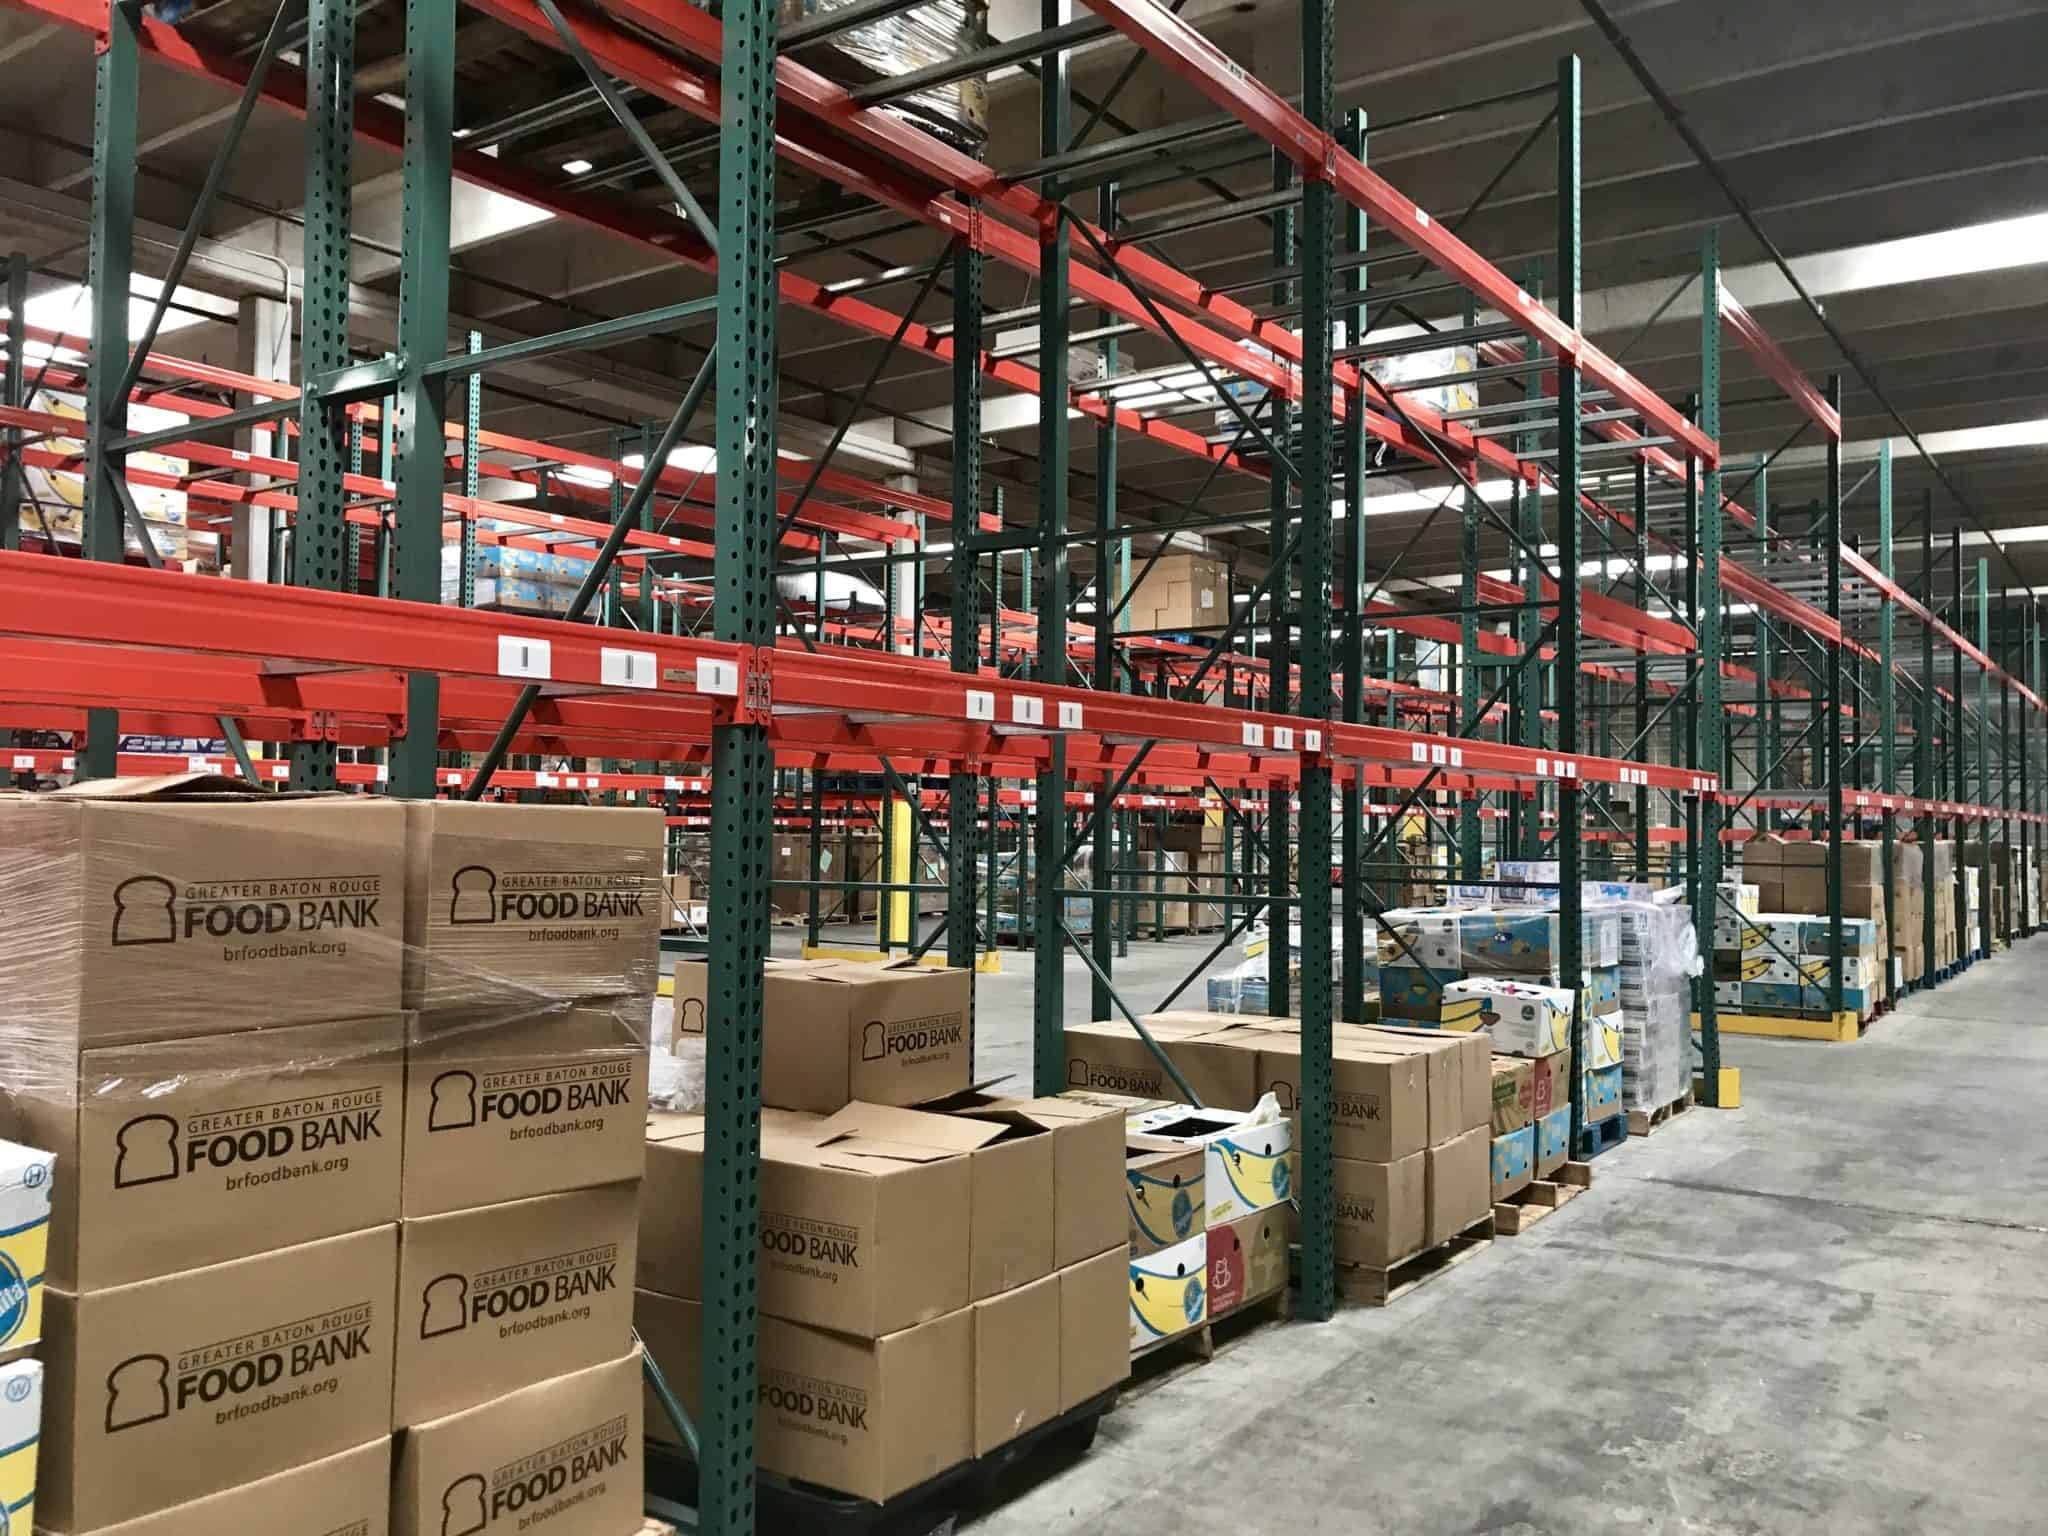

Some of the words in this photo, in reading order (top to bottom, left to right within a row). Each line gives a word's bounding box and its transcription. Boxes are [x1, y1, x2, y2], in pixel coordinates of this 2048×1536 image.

[185, 884, 261, 900] GREATER
[269, 881, 321, 896] BATON
[330, 880, 381, 893] ROUGE
[502, 875, 557, 888] GREATER
[562, 875, 601, 886] BATON
[184, 902, 291, 938] FOOD
[298, 898, 379, 931] BANK
[501, 893, 578, 920] FOOD
[584, 891, 644, 918] BANK
[224, 941, 347, 961] brfoodbank.org
[529, 928, 619, 942] brfoodbank.org
[888, 1032, 927, 1054] FOOD
[930, 1025, 962, 1047] BANK
[483, 1073, 540, 1089] GREATER
[546, 1067, 586, 1081] BATON
[592, 1062, 632, 1075] ROUGE
[1090, 1072, 1127, 1090] FOOD
[1129, 1079, 1162, 1096] BANK
[187, 1110, 264, 1134] GREATER
[272, 1101, 324, 1120] BATON
[332, 1091, 383, 1109] ROUGE
[481, 1088, 562, 1122] FOOD
[567, 1078, 630, 1111] BANK
[1342, 1103, 1380, 1121] BANK
[187, 1126, 294, 1172] FOOD
[301, 1110, 382, 1152] BANK
[510, 1118, 604, 1141] brfoodbank.org
[226, 1157, 349, 1191] brfoodbank.org
[1337, 1202, 1376, 1223] BANK
[473, 1268, 528, 1289] GREATER
[534, 1258, 573, 1275] BATON
[579, 1247, 617, 1264] ROUGE
[809, 1238, 858, 1268] BANK
[472, 1280, 549, 1323] FOOD
[555, 1264, 616, 1302] BANK
[500, 1306, 590, 1338] brfoodbank.org
[178, 1340, 254, 1371] GREATER
[262, 1323, 315, 1347] BATON
[321, 1307, 372, 1330] ROUGE
[177, 1353, 283, 1410] FOOD
[291, 1325, 371, 1377] BANK
[216, 1377, 338, 1425] brfoodbank.org
[818, 1398, 868, 1432] BANK
[492, 1465, 566, 1520] FOOD
[572, 1435, 628, 1484] BANK
